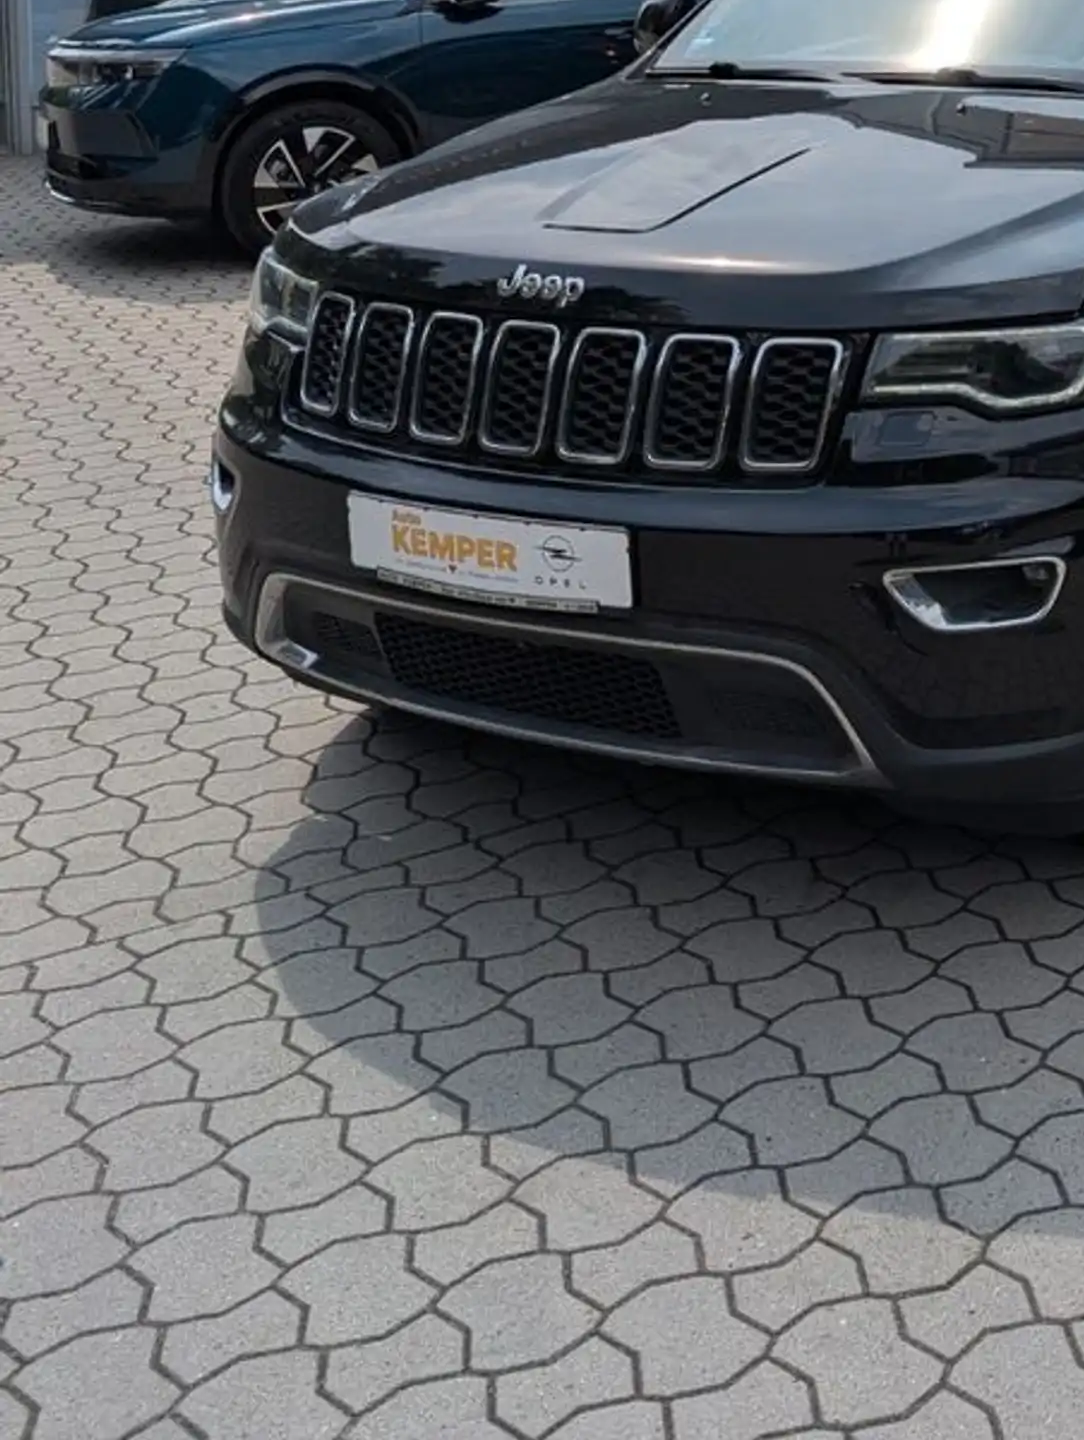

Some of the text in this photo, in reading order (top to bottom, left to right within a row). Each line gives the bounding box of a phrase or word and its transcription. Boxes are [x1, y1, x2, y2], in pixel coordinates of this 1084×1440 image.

[497, 263, 585, 308] Jeep
[390, 524, 518, 573] KEMPER
[534, 575, 588, 590] OPEL
